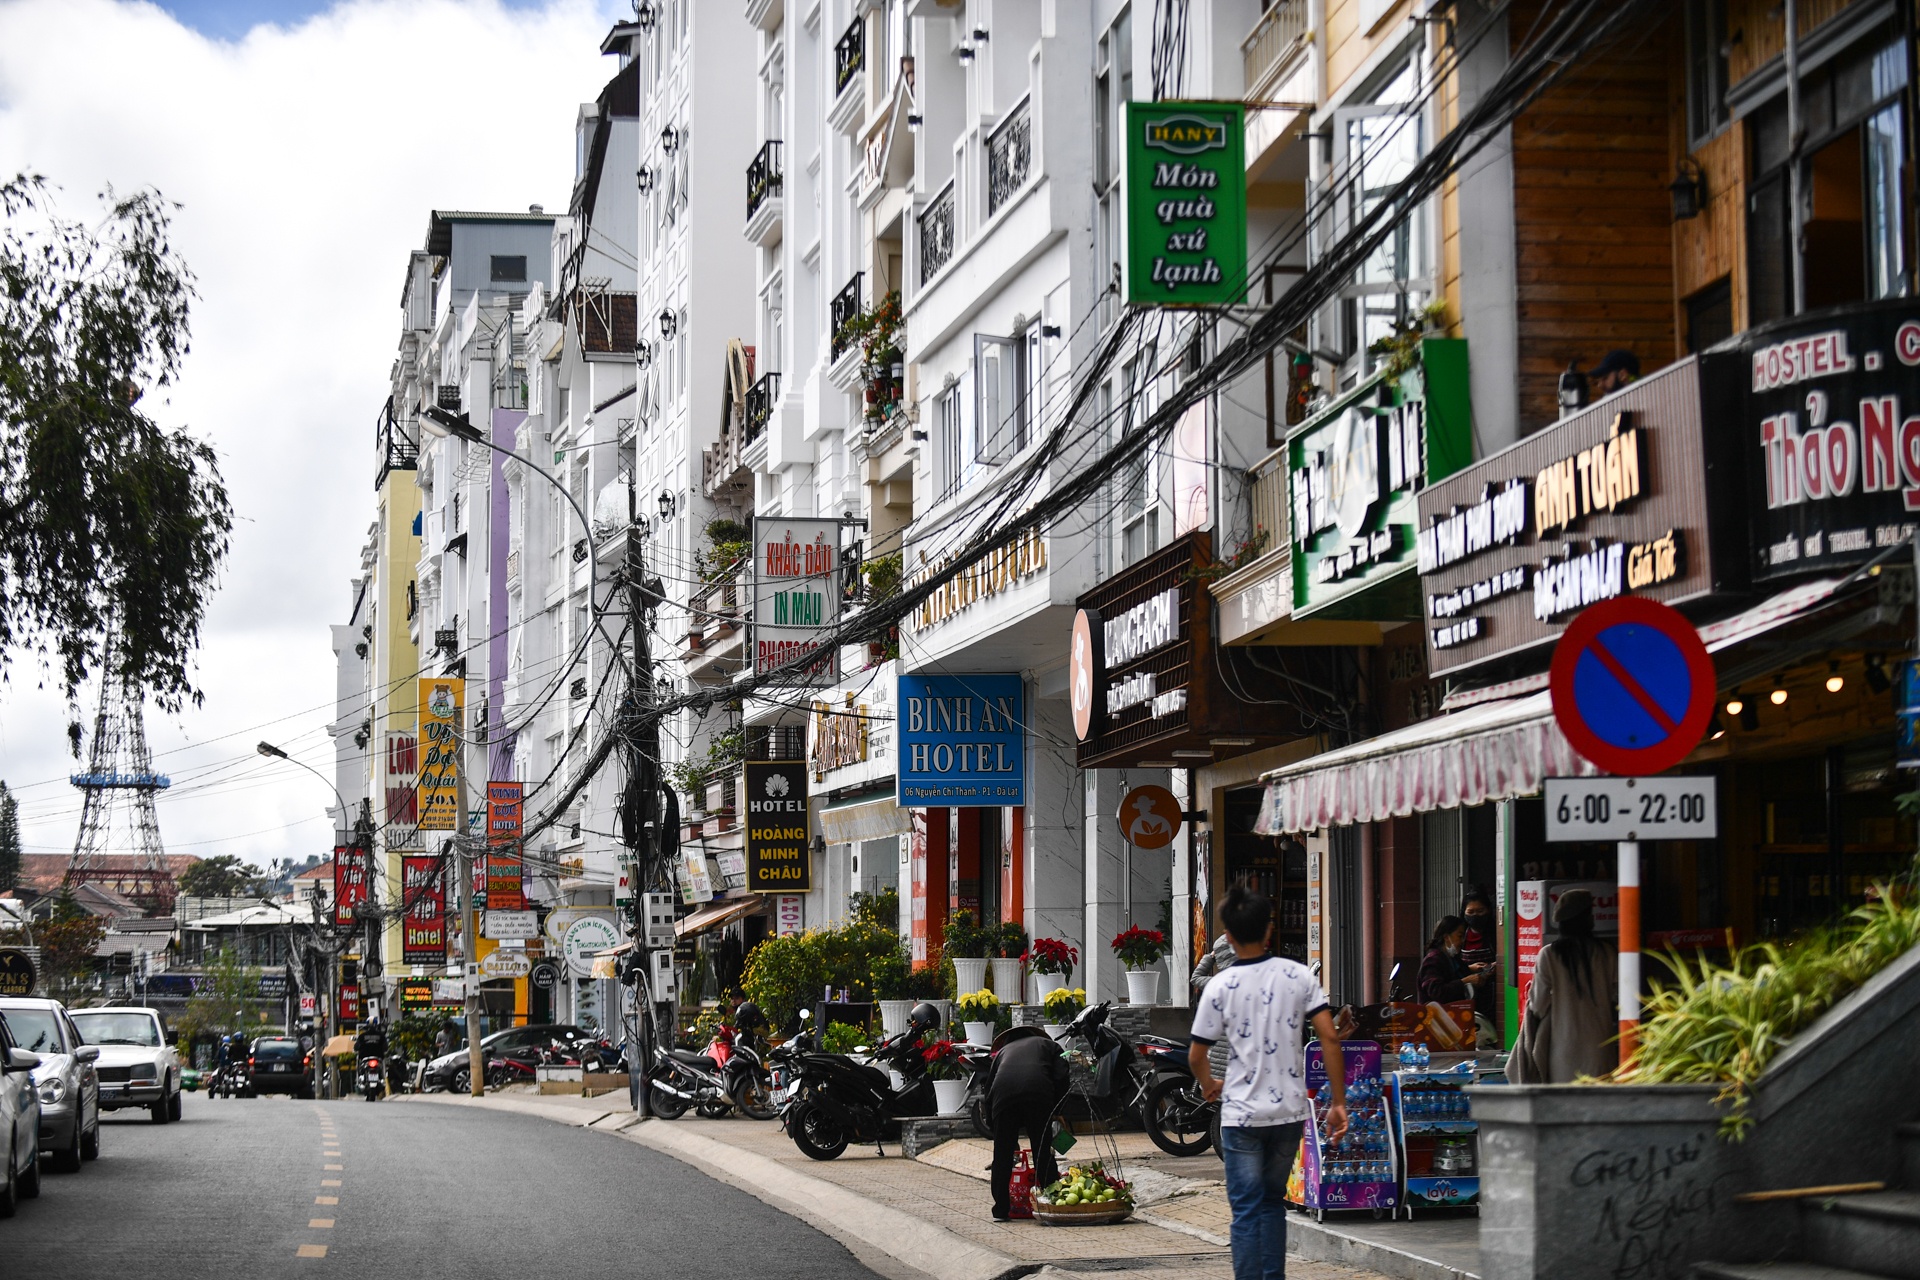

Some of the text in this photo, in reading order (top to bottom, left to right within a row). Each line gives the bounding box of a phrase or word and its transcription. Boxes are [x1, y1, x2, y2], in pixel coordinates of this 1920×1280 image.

[1154, 127, 1217, 141] HANY
[1154, 162, 1218, 188] Món
[1157, 194, 1215, 223] quà
[1168, 228, 1207, 251] xứ
[1152, 257, 1222, 289] lạnh
[766, 529, 831, 578] KHẮC DẤU
[1628, 542, 1653, 589] Giá
[1653, 528, 1676, 583] Tốt
[774, 585, 822, 626] IN MÀU
[907, 685, 973, 732] BÌNH
[978, 697, 1014, 732] AN
[389, 737, 417, 775] LON
[909, 743, 1014, 772] HOTEL
[490, 788, 520, 798] VINH
[905, 787, 914, 797] 06
[915, 784, 941, 798] Nguyễn
[955, 786, 977, 796] Thanh
[982, 786, 991, 796] P1
[1007, 786, 1018, 798] Lạt
[750, 800, 806, 813] HOTEL
[1557, 794, 1610, 824] 6:00
[1639, 794, 1705, 824] 22:00
[492, 820, 519, 830] HOTEL
[751, 824, 805, 840] HOÀNG
[387, 829, 424, 848] HOTEL
[338, 852, 366, 871] Hong
[759, 848, 799, 860] MINH
[489, 865, 521, 878] HẠNH
[758, 865, 802, 880] CHÂU
[489, 882, 520, 890] BEAUTY SALON
[350, 889, 356, 902] 2
[409, 928, 441, 945] Hotel
[1312, 1060, 1324, 1069] Or
[1327, 1193, 1347, 1202] Oris
[1427, 1186, 1458, 1198] laVie
